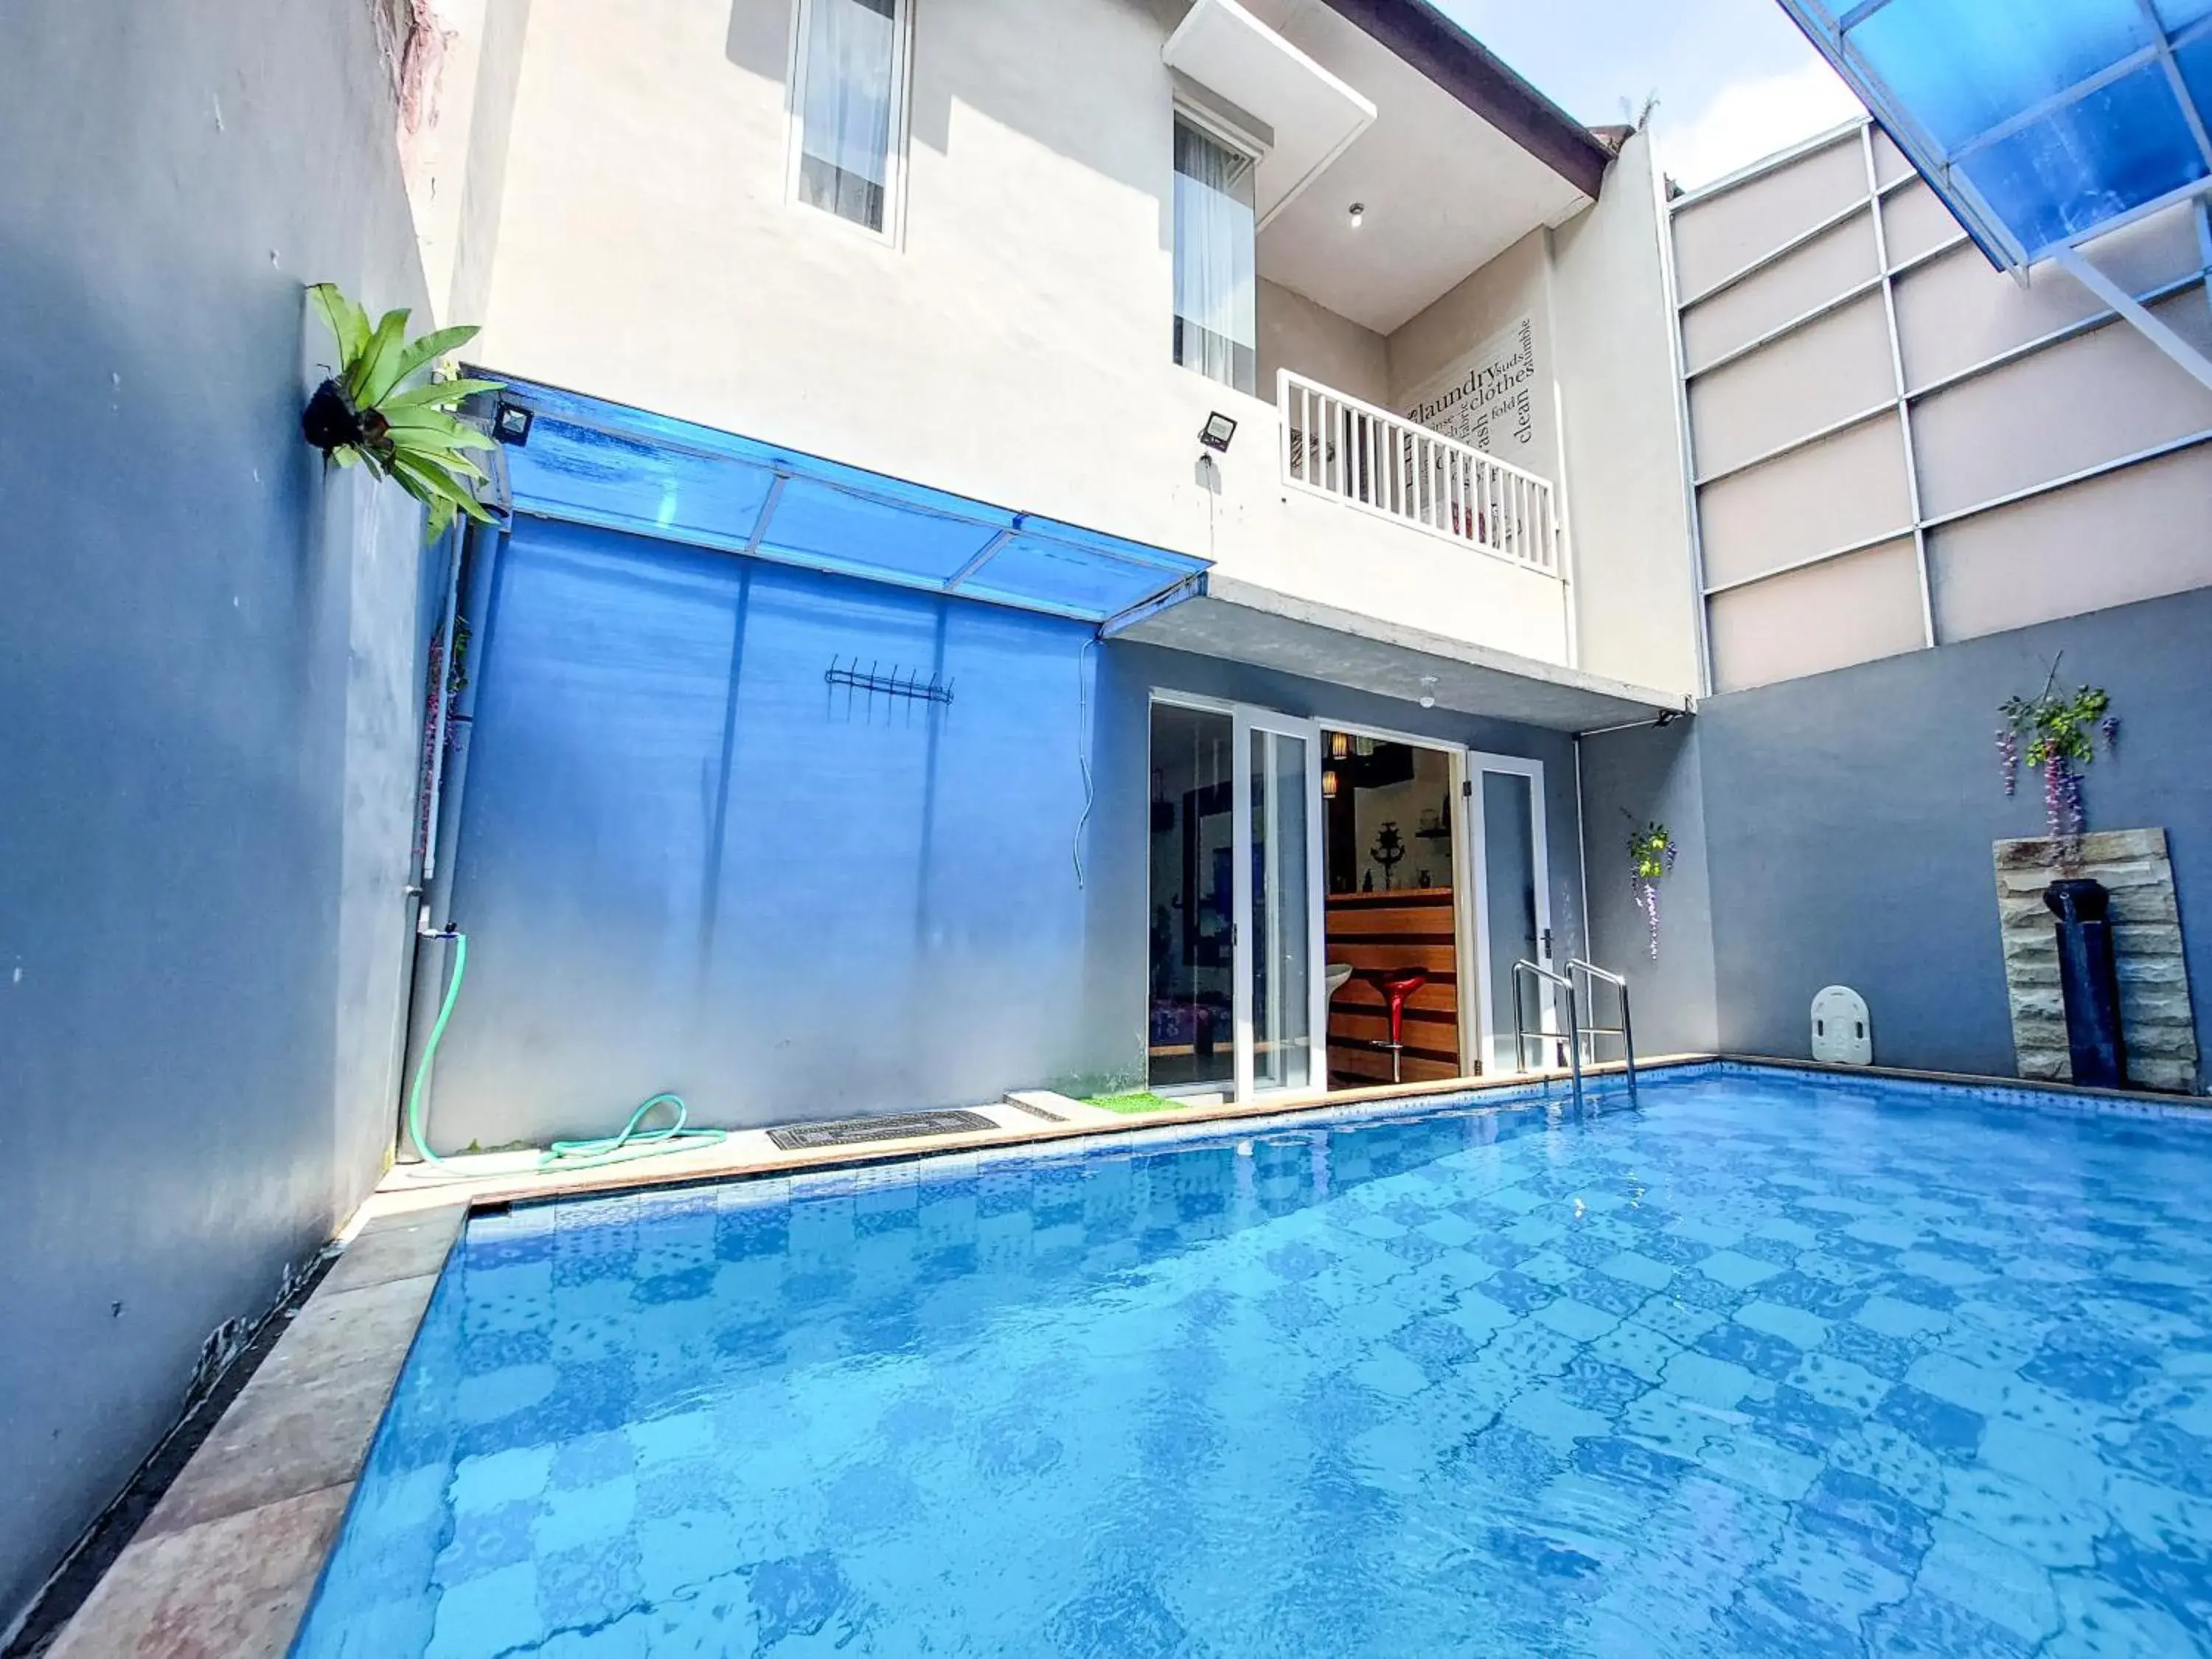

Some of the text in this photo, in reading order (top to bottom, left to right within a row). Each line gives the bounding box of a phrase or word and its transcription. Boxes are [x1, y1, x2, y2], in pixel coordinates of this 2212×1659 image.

[1519, 318, 1534, 367] tumble
[1418, 362, 1498, 423] laundry
[1470, 367, 1534, 411] clothes
[1492, 396, 1515, 420] fold
[1472, 414, 1490, 454] ash
[1514, 388, 1531, 443] clean
